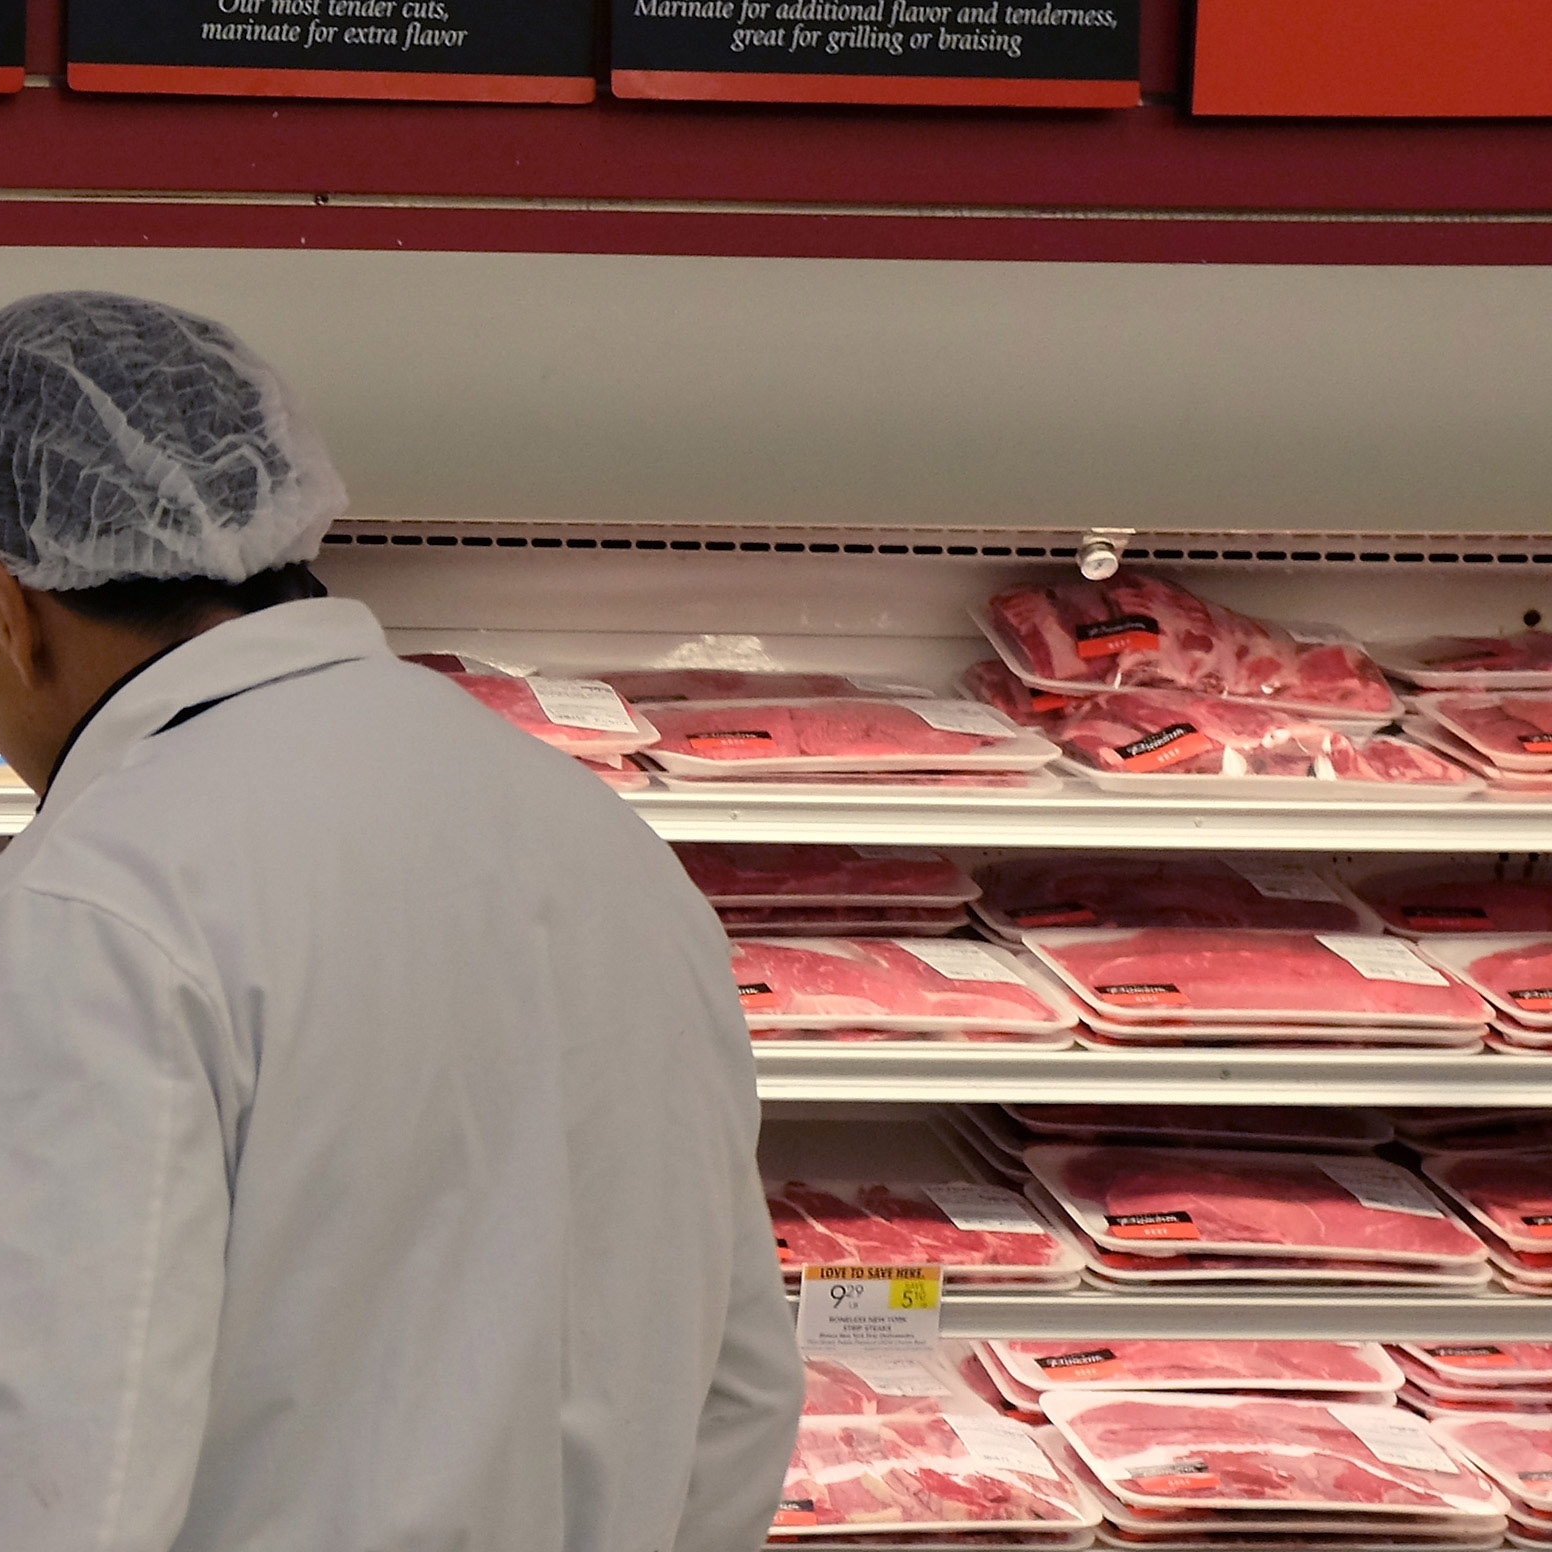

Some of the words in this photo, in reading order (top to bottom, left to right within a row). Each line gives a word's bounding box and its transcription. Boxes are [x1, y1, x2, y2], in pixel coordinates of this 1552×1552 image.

[270, 0, 321, 16] most
[328, 0, 396, 18] tender
[401, 0, 450, 22] cuts,
[634, 0, 734, 18] Marinate
[738, 0, 771, 24] for
[775, 0, 884, 21] additional
[890, 0, 954, 26] flavor
[957, 2, 998, 25] and
[1004, 2, 1118, 29] tenderness,
[201, 19, 301, 41] marinate
[304, 19, 338, 49] for
[344, 24, 397, 45] extra
[401, 21, 468, 51] flavor
[730, 27, 786, 51] great
[789, 23, 824, 52] for
[827, 26, 904, 56] grilling
[910, 33, 934, 51] or
[938, 31, 1022, 57] braising
[821, 1267, 846, 1279] LOVE
[850, 1267, 864, 1279] TO
[868, 1267, 892, 1279] SAVE
[896, 1267, 925, 1279] HERE.
